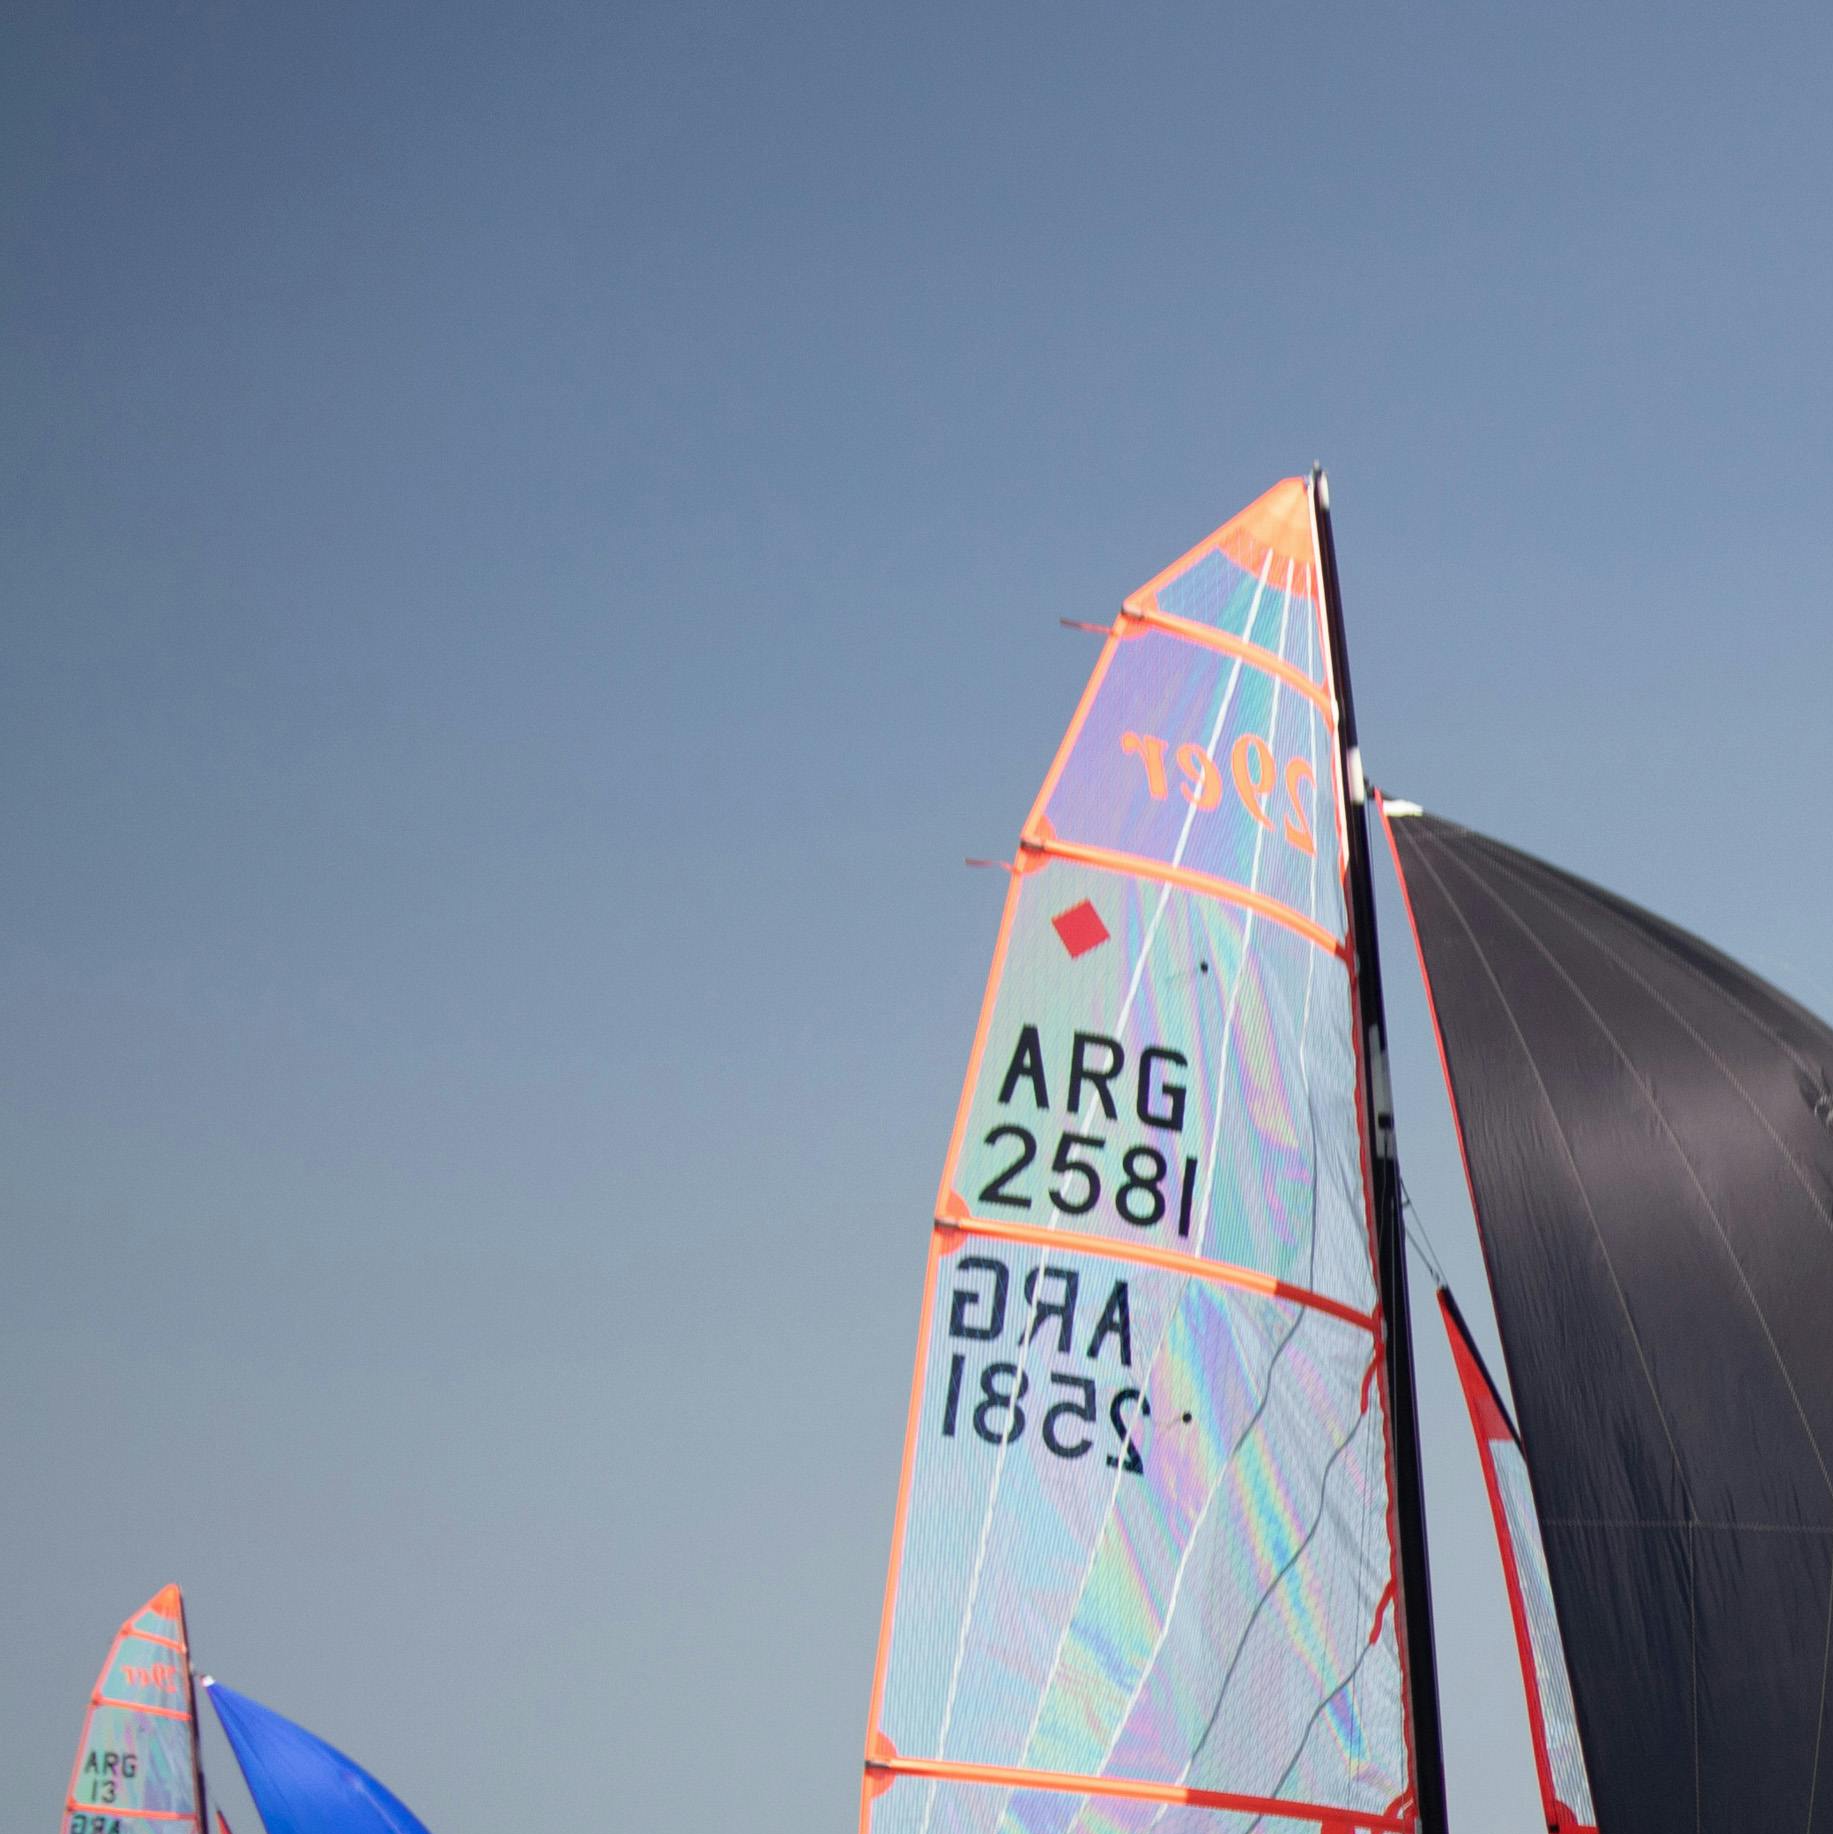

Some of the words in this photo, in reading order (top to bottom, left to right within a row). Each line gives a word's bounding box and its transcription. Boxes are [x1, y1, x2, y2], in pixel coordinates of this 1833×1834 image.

[998, 1023, 1188, 1133] ARG
[978, 1124, 1198, 1238] 2581
[84, 1751, 138, 1778] ARG
[91, 1778, 116, 1803] 13
